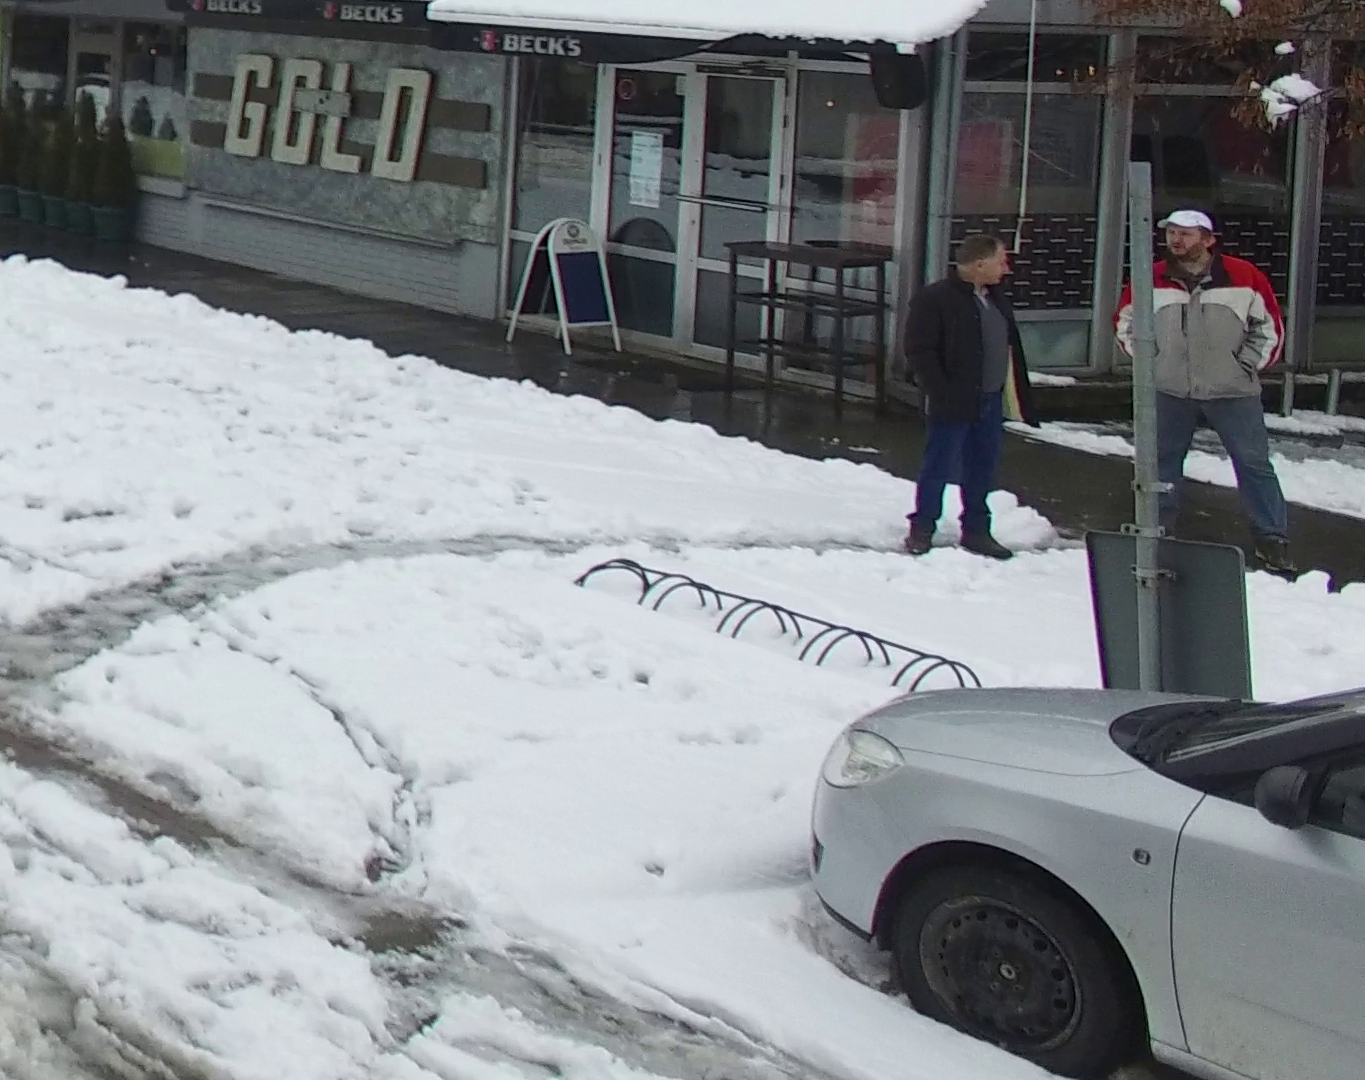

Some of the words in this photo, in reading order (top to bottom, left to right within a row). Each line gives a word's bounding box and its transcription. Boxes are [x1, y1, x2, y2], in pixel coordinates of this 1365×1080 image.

[340, 3, 403, 23] BECK'S
[502, 32, 581, 57] BECK'S
[224, 53, 432, 182] GOLD
